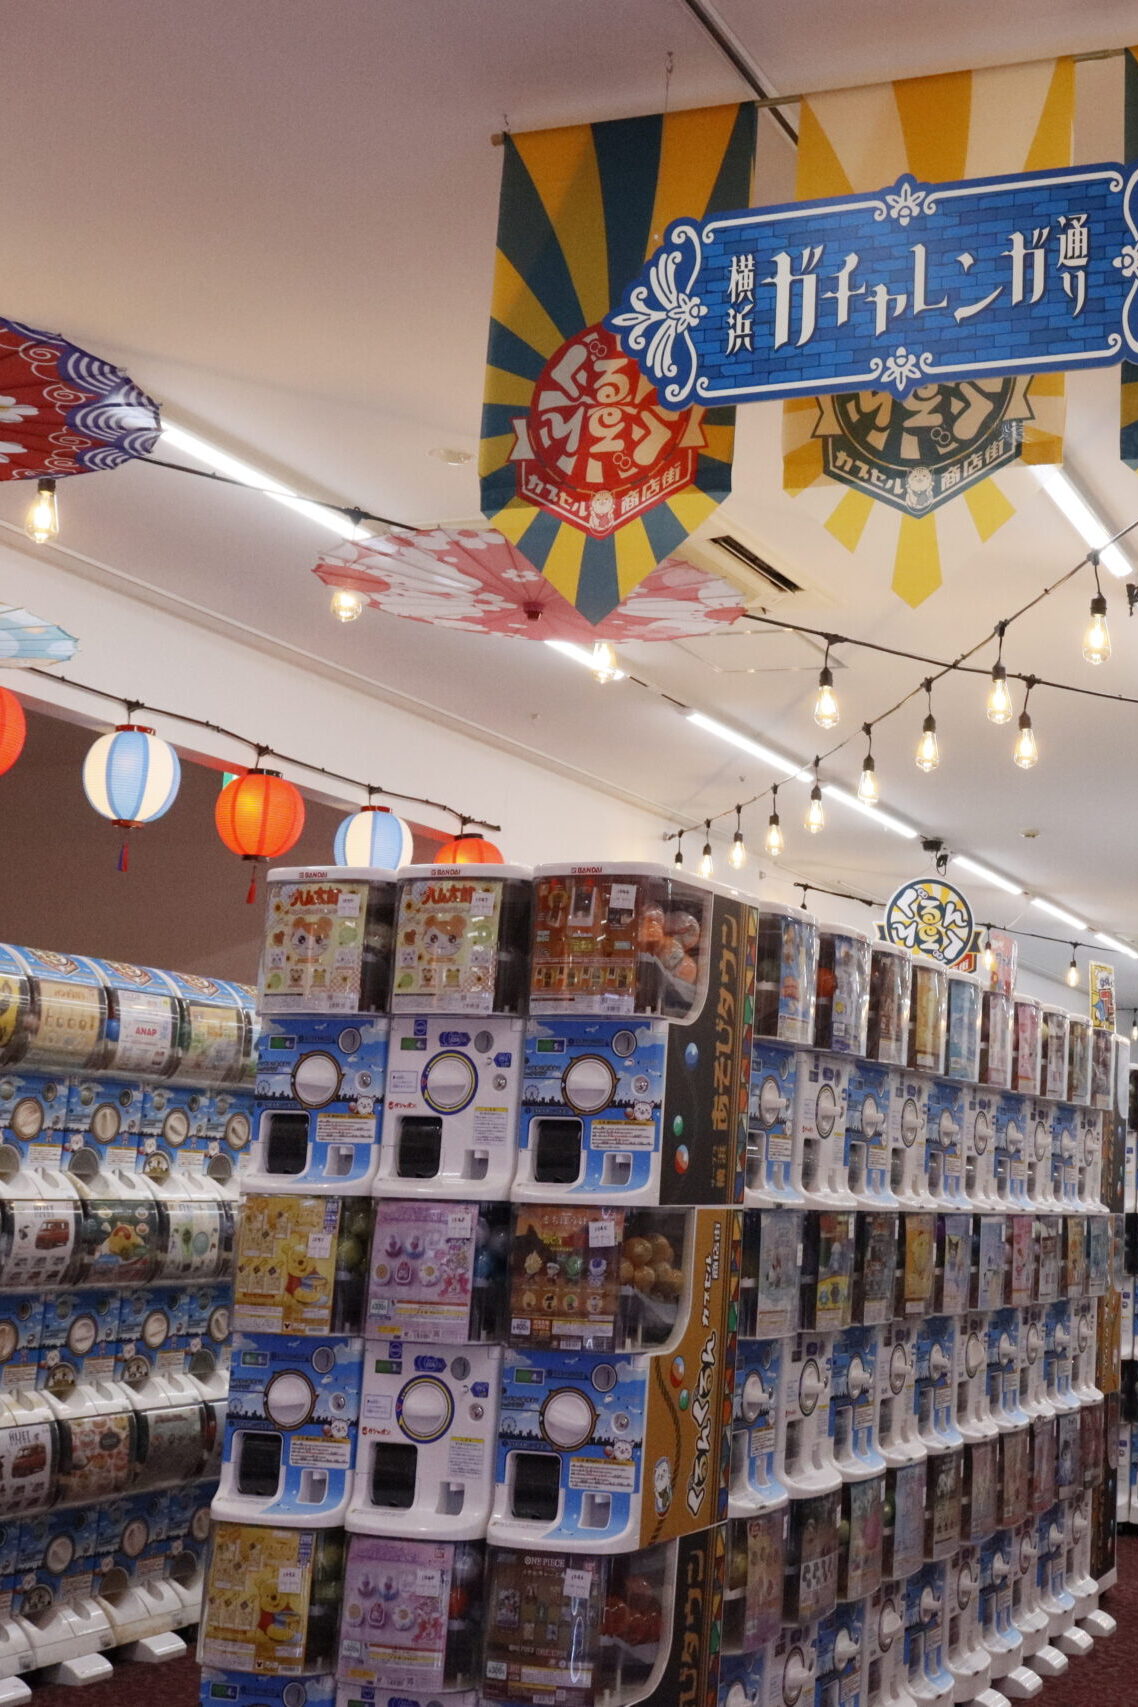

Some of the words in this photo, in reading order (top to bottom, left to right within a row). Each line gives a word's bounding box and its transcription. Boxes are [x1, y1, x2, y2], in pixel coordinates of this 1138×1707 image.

[726, 254, 756, 355] 横浜
[760, 227, 1050, 351] ガチャレンガ
[1056, 213, 1089, 318] 通り
[528, 474, 588, 517] カプセル
[620, 462, 682, 514] 商店街
[835, 450, 905, 495] カプセル
[940, 439, 1005, 491] 商店街
[135, 1027, 158, 1037] ANAP
